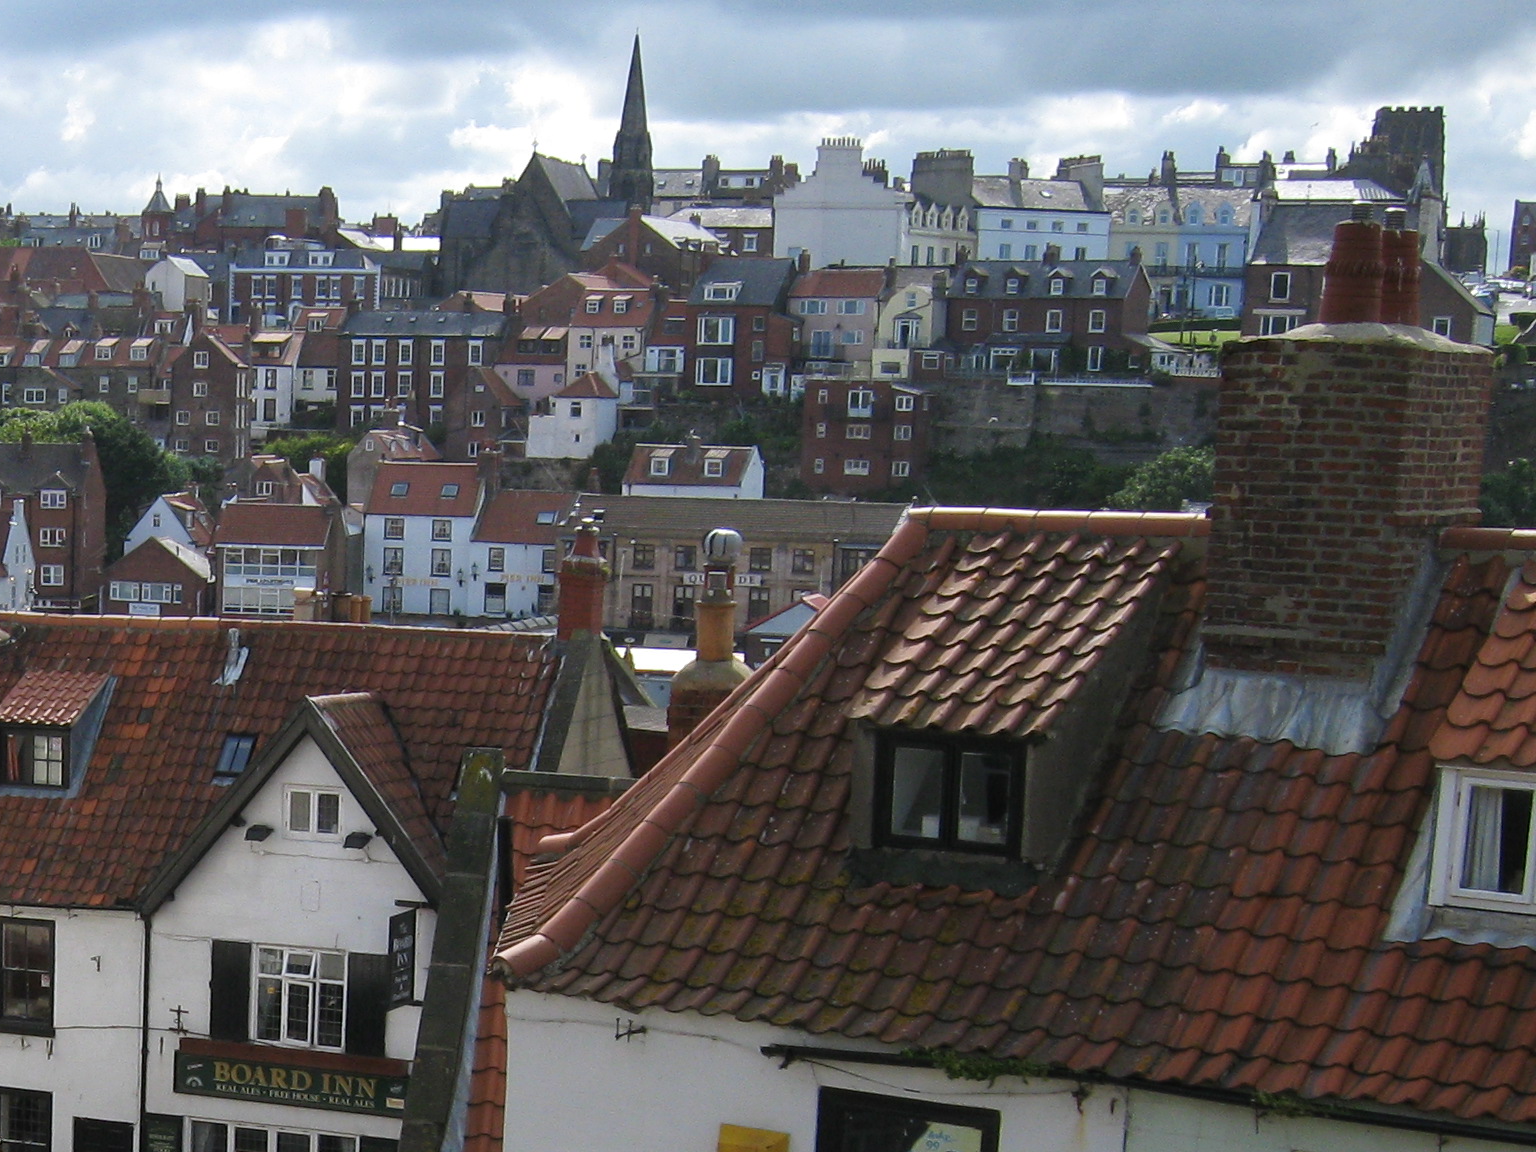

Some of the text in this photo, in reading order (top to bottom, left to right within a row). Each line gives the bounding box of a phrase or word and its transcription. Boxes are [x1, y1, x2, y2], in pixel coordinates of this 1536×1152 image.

[213, 1061, 378, 1099] BOARD INN
[216, 1082, 238, 1093] REAL
[240, 1085, 262, 1096] ALES
[269, 1089, 289, 1100] FREE
[292, 1091, 321, 1103] HOUSE
[329, 1096, 352, 1106] REAL
[354, 1099, 376, 1109] ALES
